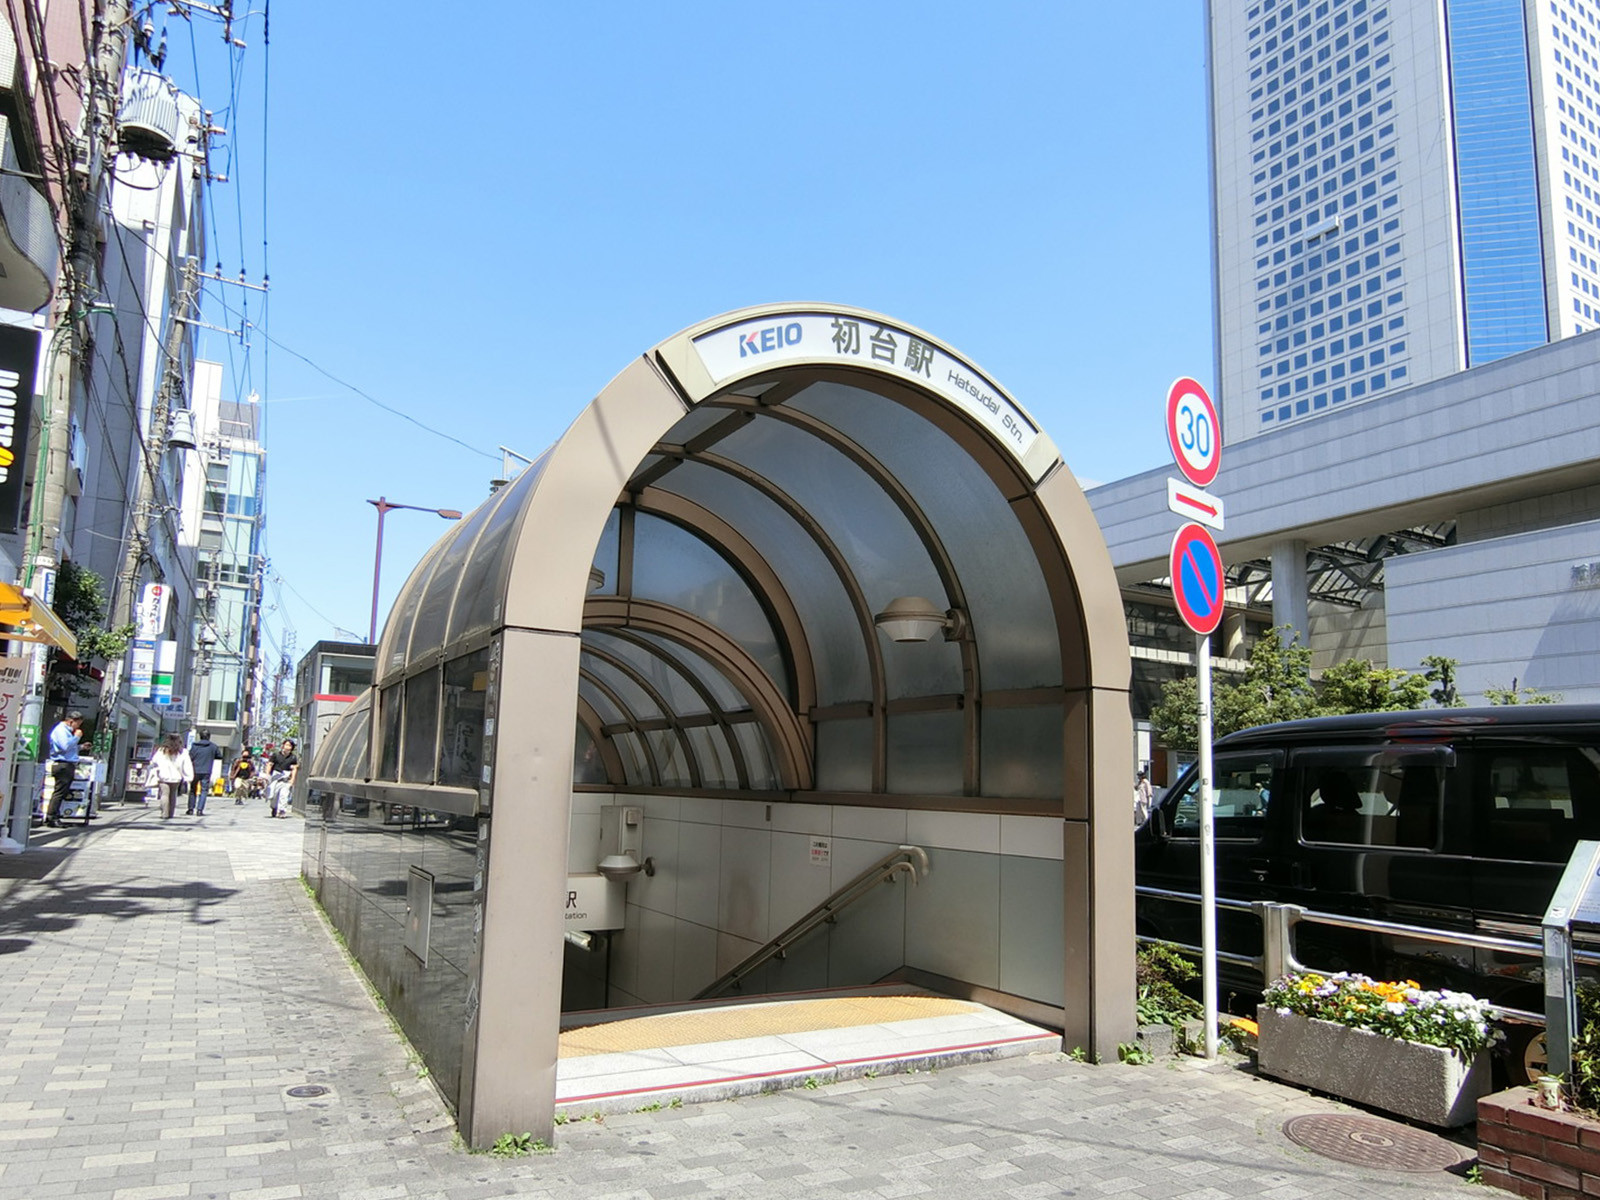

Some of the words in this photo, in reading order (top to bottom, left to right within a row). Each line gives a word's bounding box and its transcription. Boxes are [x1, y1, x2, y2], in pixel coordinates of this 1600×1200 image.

[739, 322, 803, 358] KEIO
[831, 316, 935, 378] 初台駅
[947, 369, 1001, 415] Hatsudai
[1002, 414, 1023, 443] Stn.
[1181, 405, 1210, 457] 30
[565, 912, 587, 920] tation
